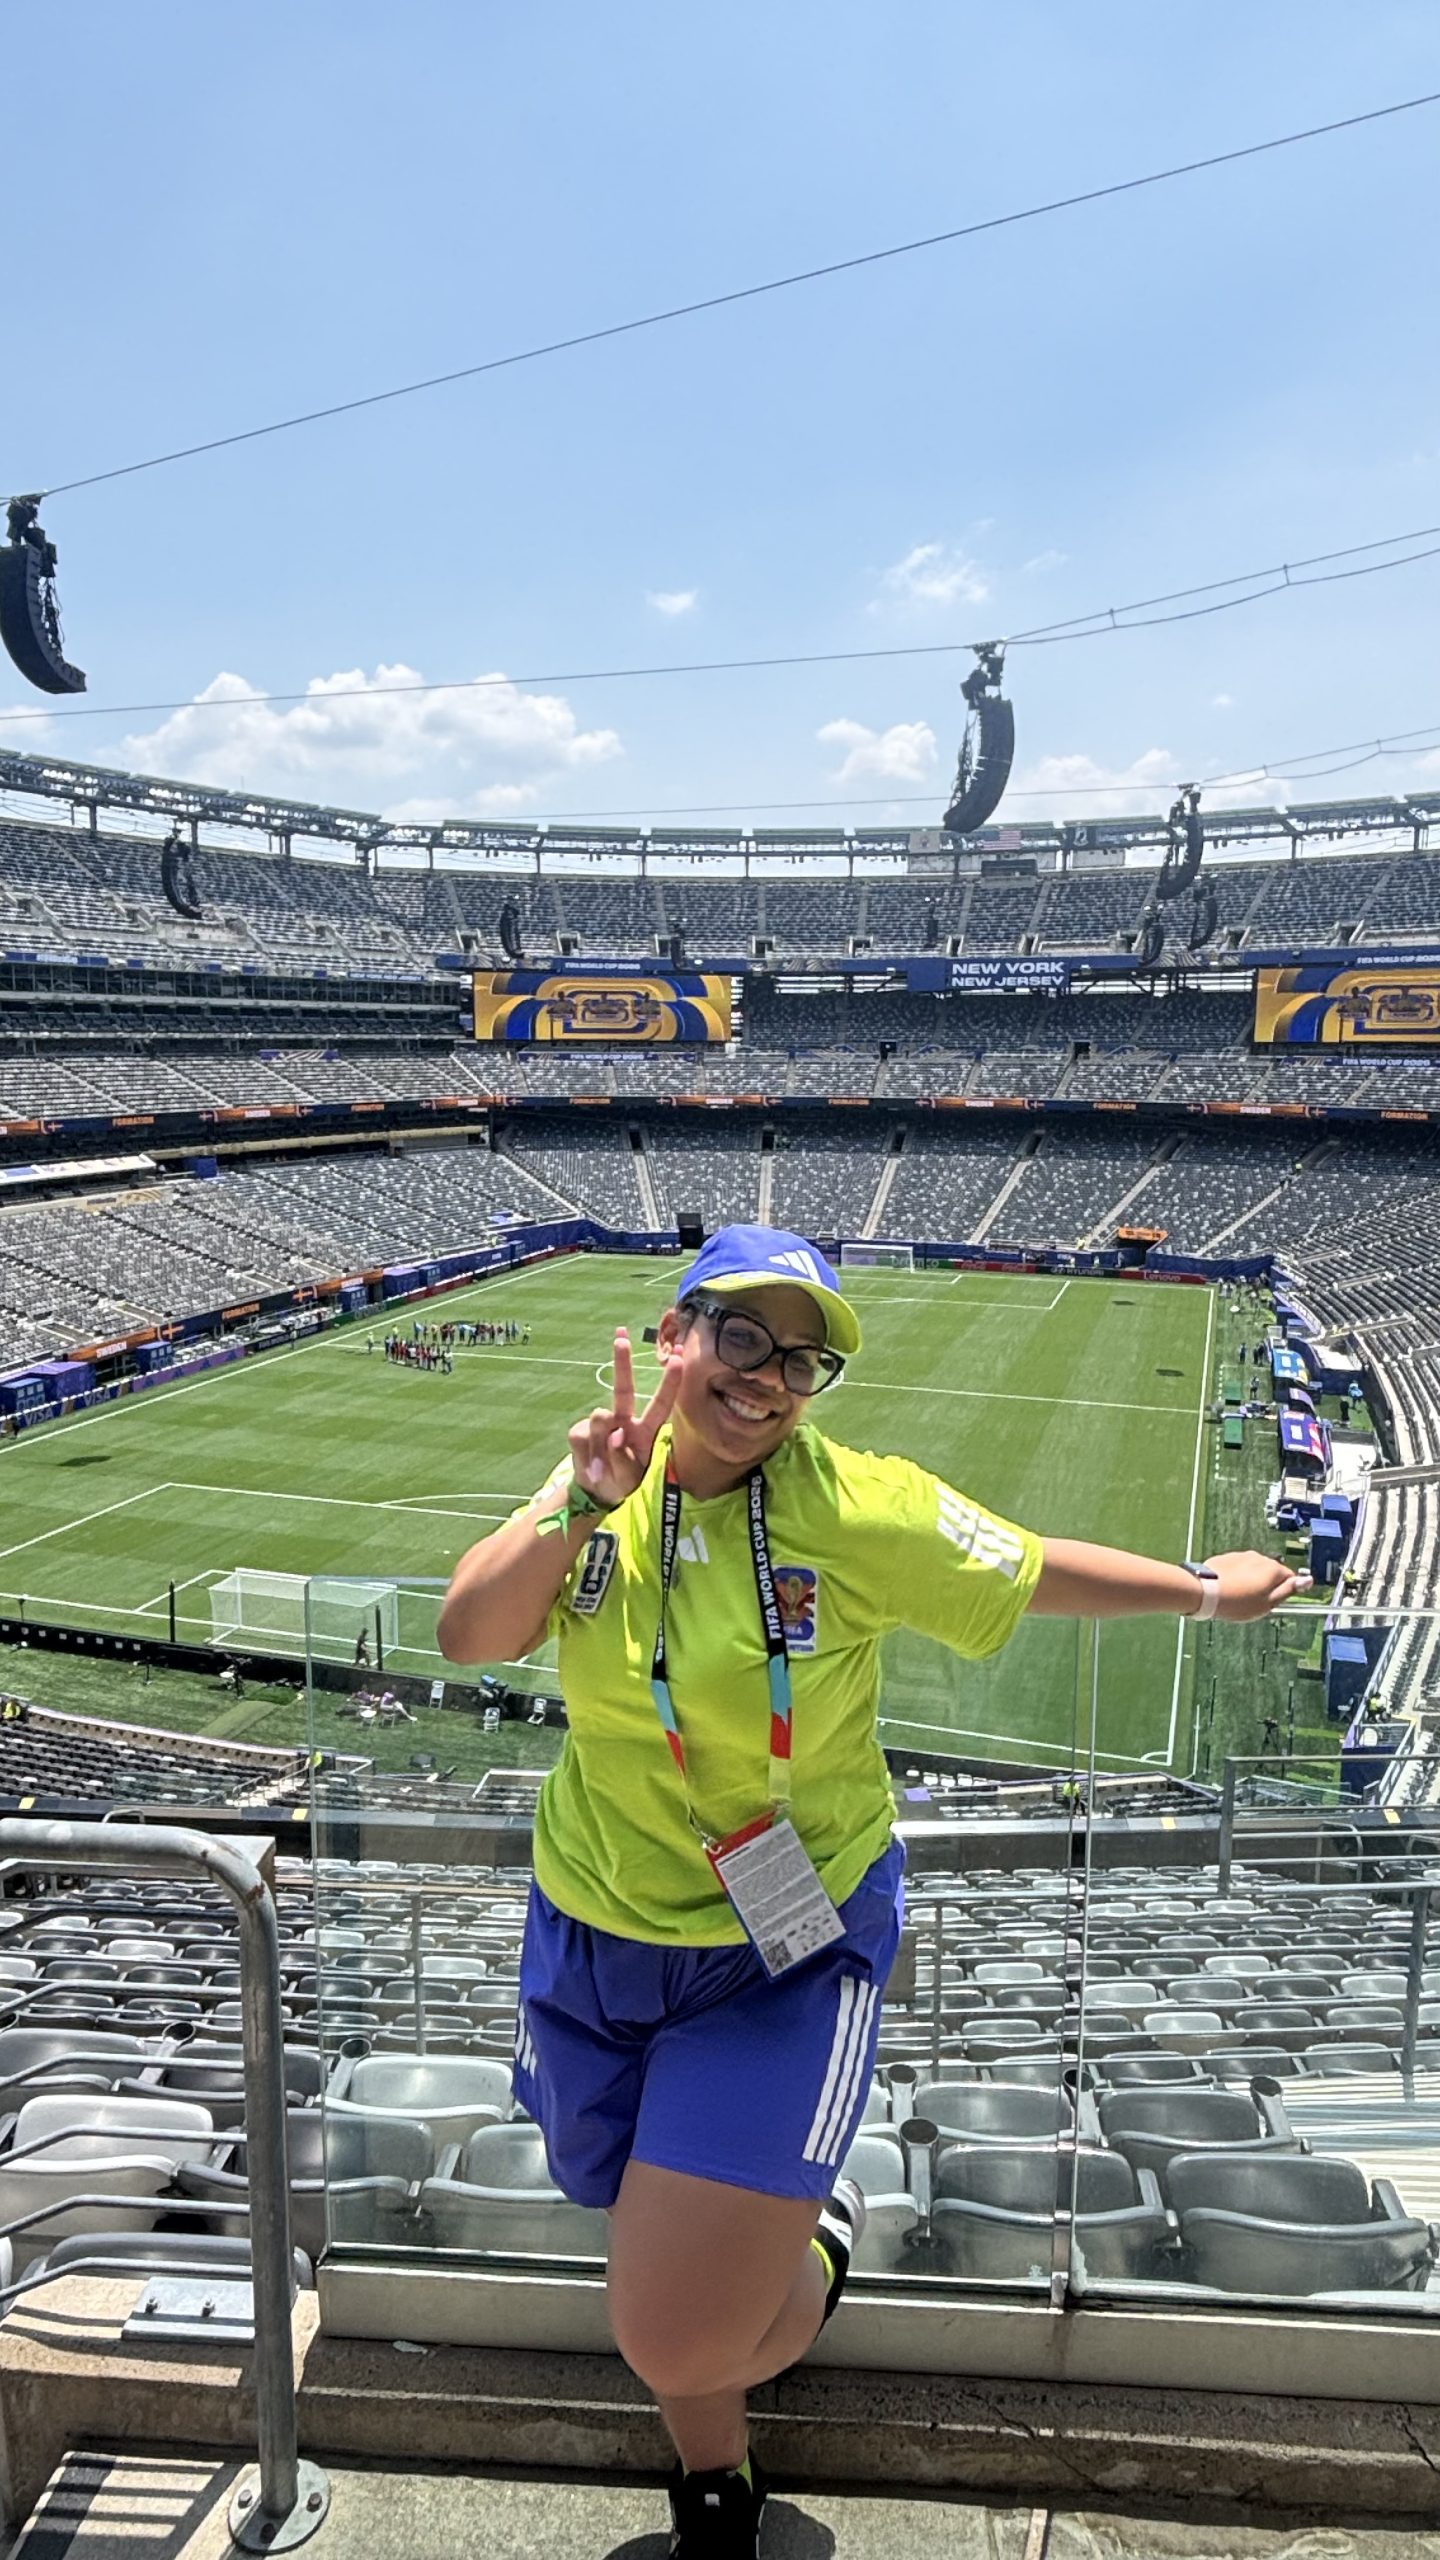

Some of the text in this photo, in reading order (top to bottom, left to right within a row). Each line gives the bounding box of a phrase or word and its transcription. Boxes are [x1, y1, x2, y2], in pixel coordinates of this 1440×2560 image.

[952, 962, 1064, 974] NEW YORK
[952, 976, 1064, 987] NEW JERSEY
[1143, 1271, 1182, 1283] Lenovo
[84, 1389, 110, 1407] VISA
[25, 1409, 54, 1427] VISA
[664, 1493, 678, 1524] FIFA
[663, 1525, 675, 1575] WORLD
[751, 1475, 782, 1640] FIFA WORLD CUP 2026
